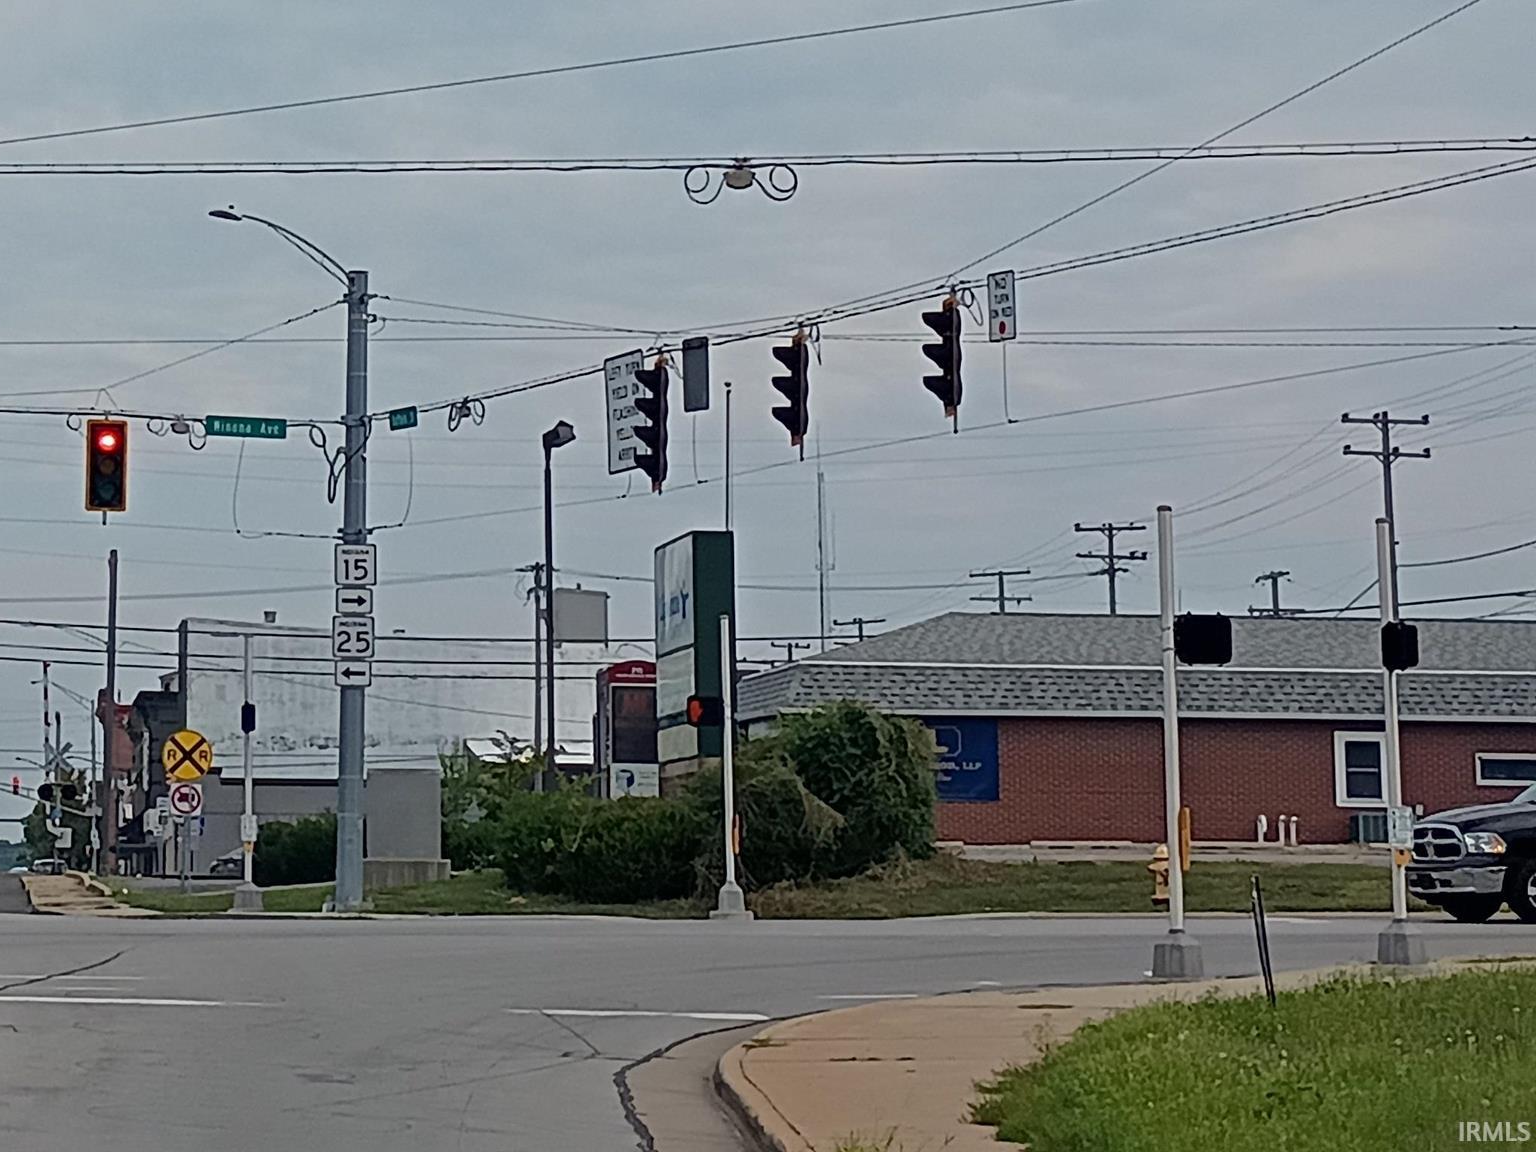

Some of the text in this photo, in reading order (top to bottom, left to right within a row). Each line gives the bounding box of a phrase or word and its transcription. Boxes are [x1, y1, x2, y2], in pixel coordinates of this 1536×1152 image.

[213, 420, 280, 435] Winona Ave
[343, 558, 368, 581] 15
[336, 630, 371, 653] 25
[167, 749, 208, 762] R R
